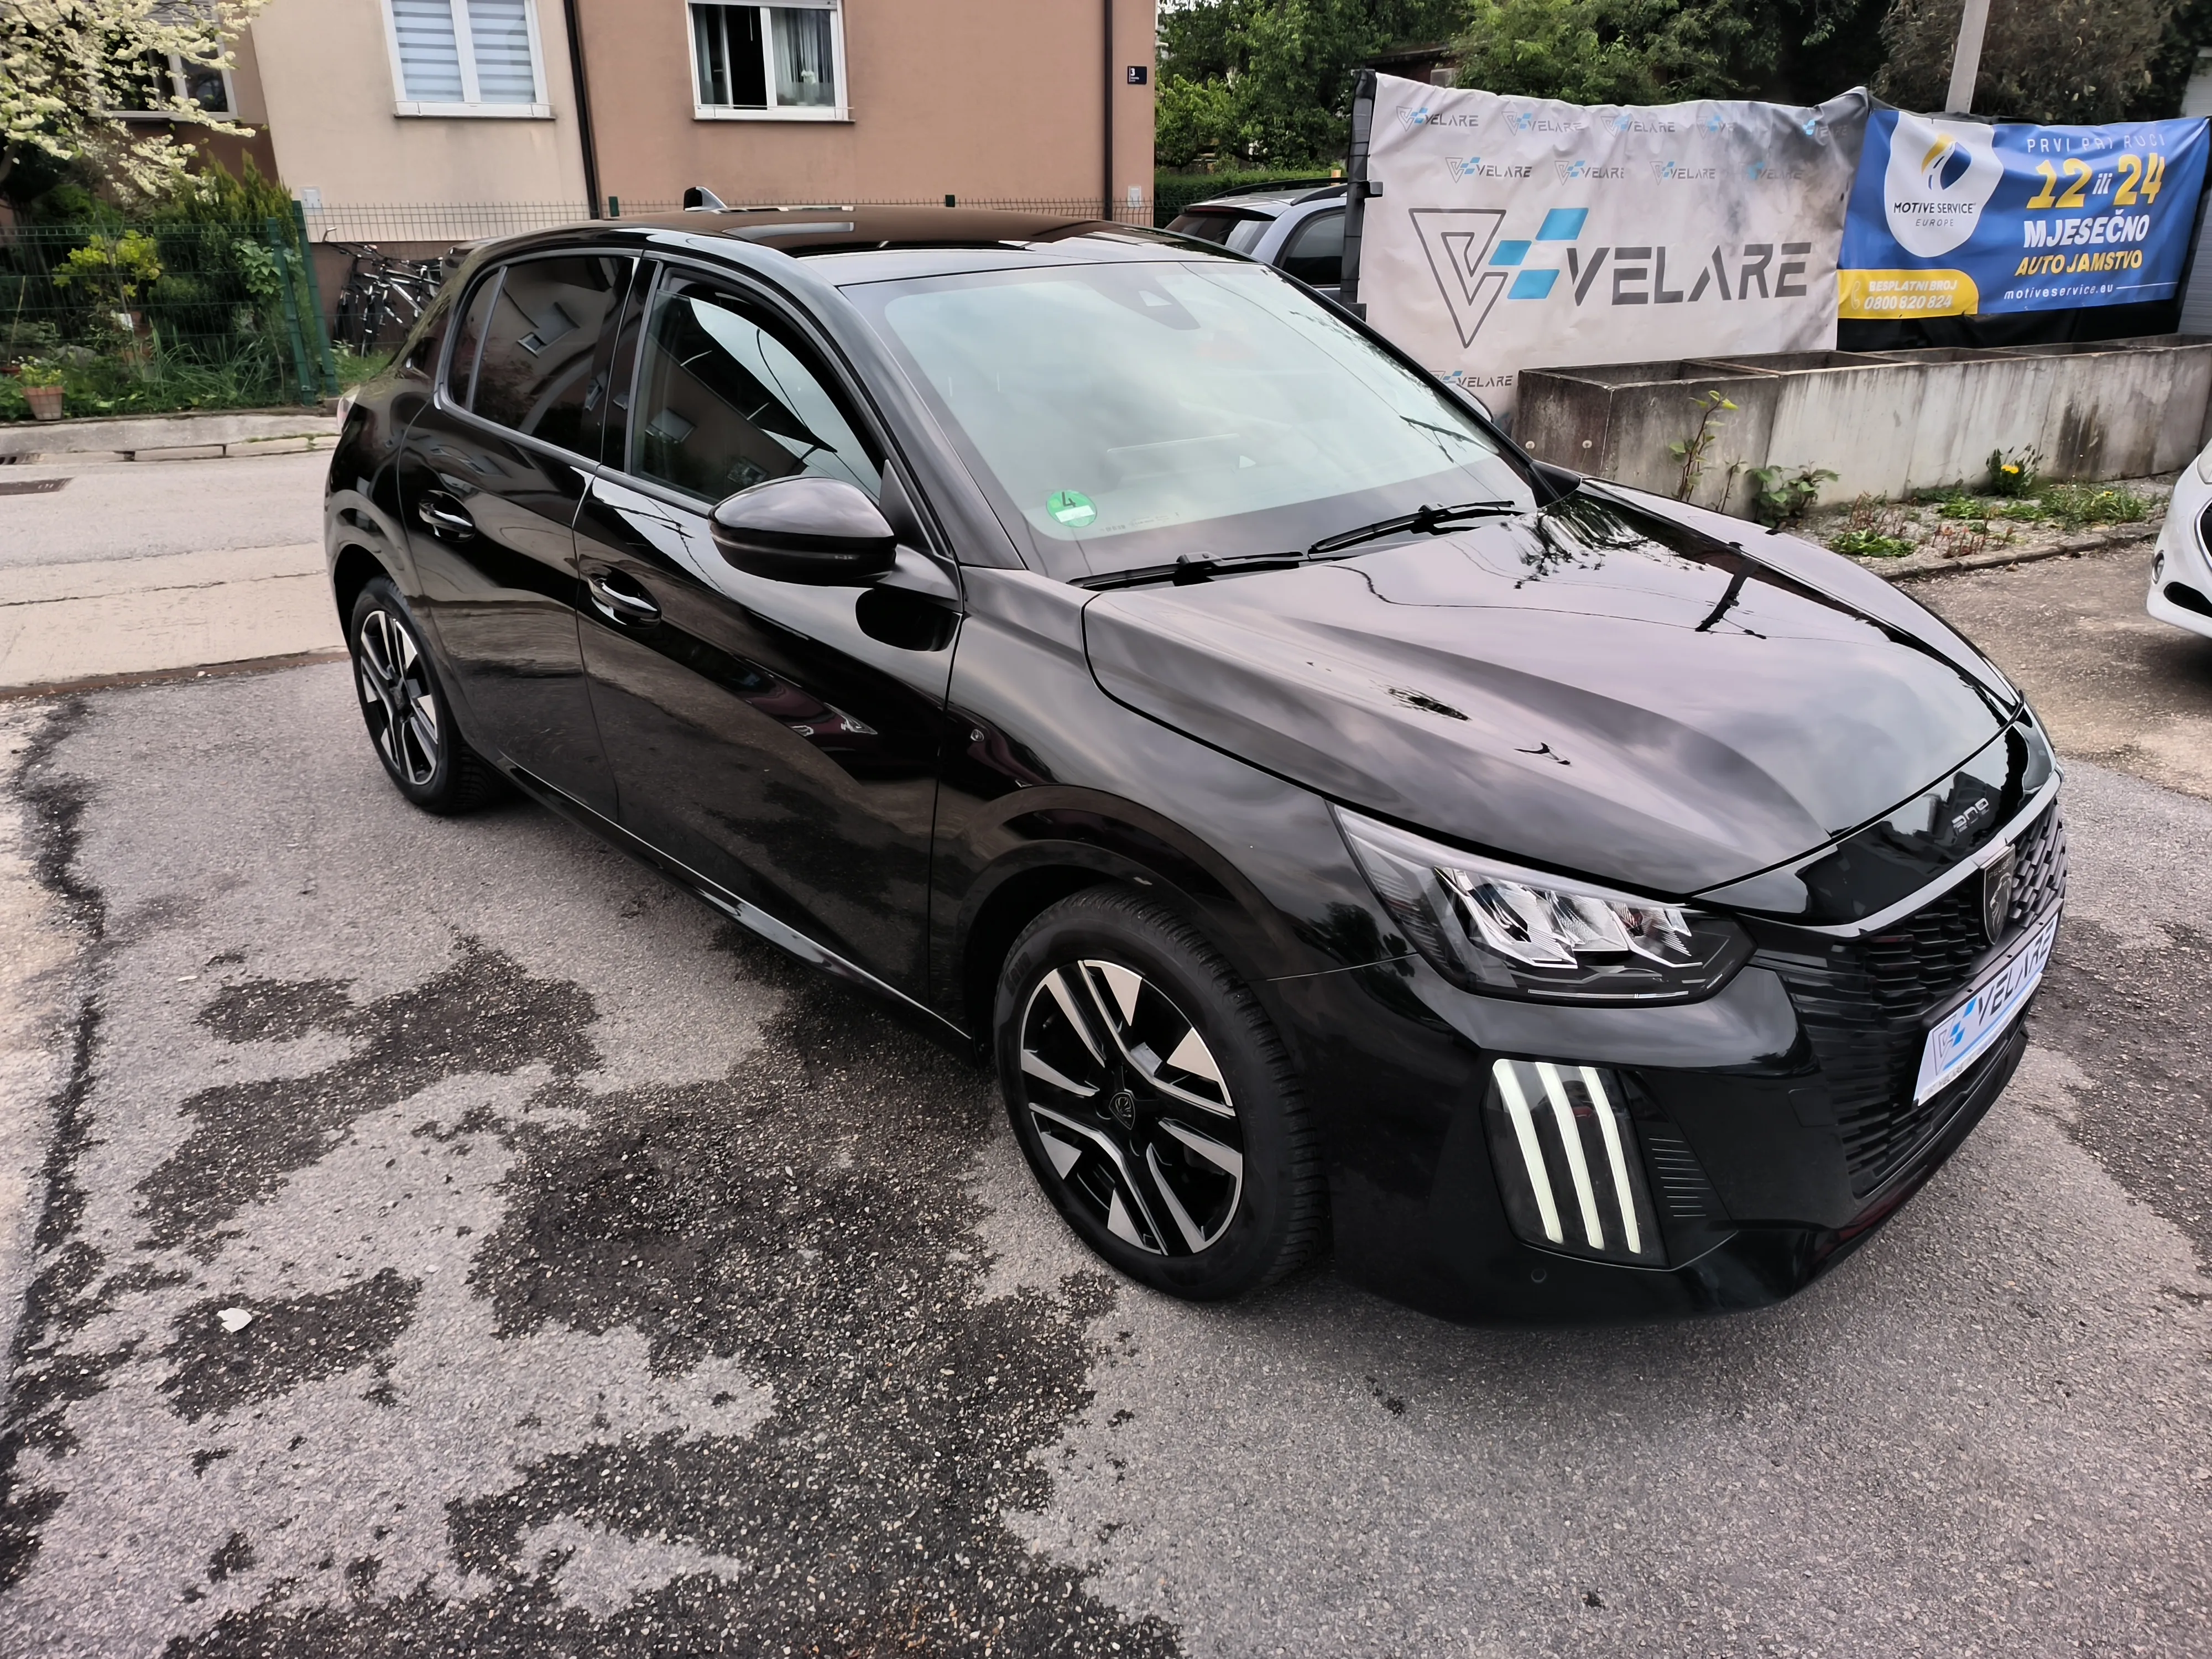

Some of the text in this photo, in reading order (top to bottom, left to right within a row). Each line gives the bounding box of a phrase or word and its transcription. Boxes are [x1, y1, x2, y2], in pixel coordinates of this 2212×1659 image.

[1425, 114, 1479, 127] VELARE
[1528, 120, 1585, 132] VELARE
[2027, 138, 2070, 153] PRVI
[1476, 164, 1532, 178] VELARE
[1670, 168, 1715, 179] VELARE
[2026, 153, 2165, 208] 12 ili 24
[1893, 202, 1973, 213] MOTIVE SERVICE
[2023, 209, 2150, 248] MJESEČNO
[2015, 249, 2143, 276] AUTO JAMSTVO
[1566, 242, 1812, 306] VELARE
[1869, 280, 1958, 292] BESPLATNI BROJ
[2004, 284, 2114, 300] motiveservice.eu
[1864, 294, 1953, 310] 0800 820 824
[1458, 375, 1514, 388] VELARE
[1061, 491, 1076, 508] 4
[1989, 854, 2014, 880] PEUGE
[1978, 919, 2054, 1026] VELARE
